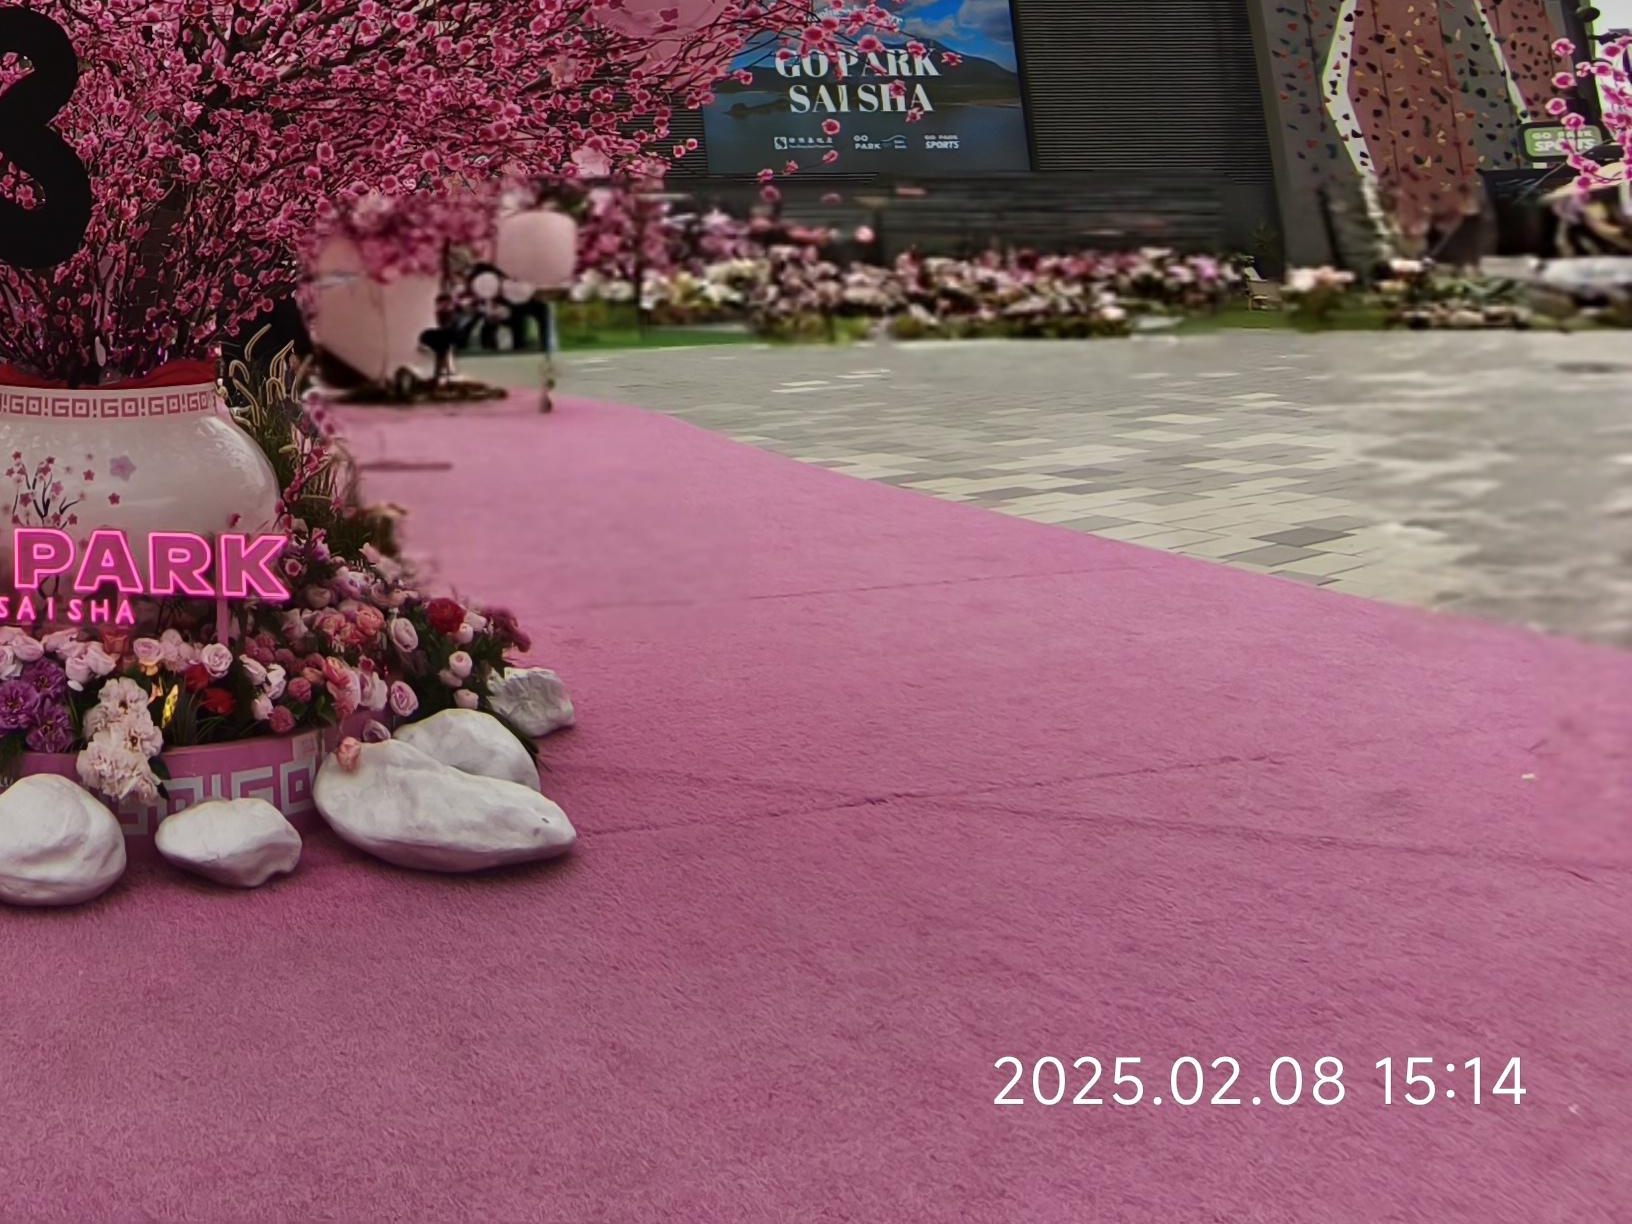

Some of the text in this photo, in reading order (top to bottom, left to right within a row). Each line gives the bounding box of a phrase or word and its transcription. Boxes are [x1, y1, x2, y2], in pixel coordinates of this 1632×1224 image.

[775, 48, 941, 77] GO PARK
[789, 83, 935, 113] SAI SHA
[13, 528, 291, 600] PARK
